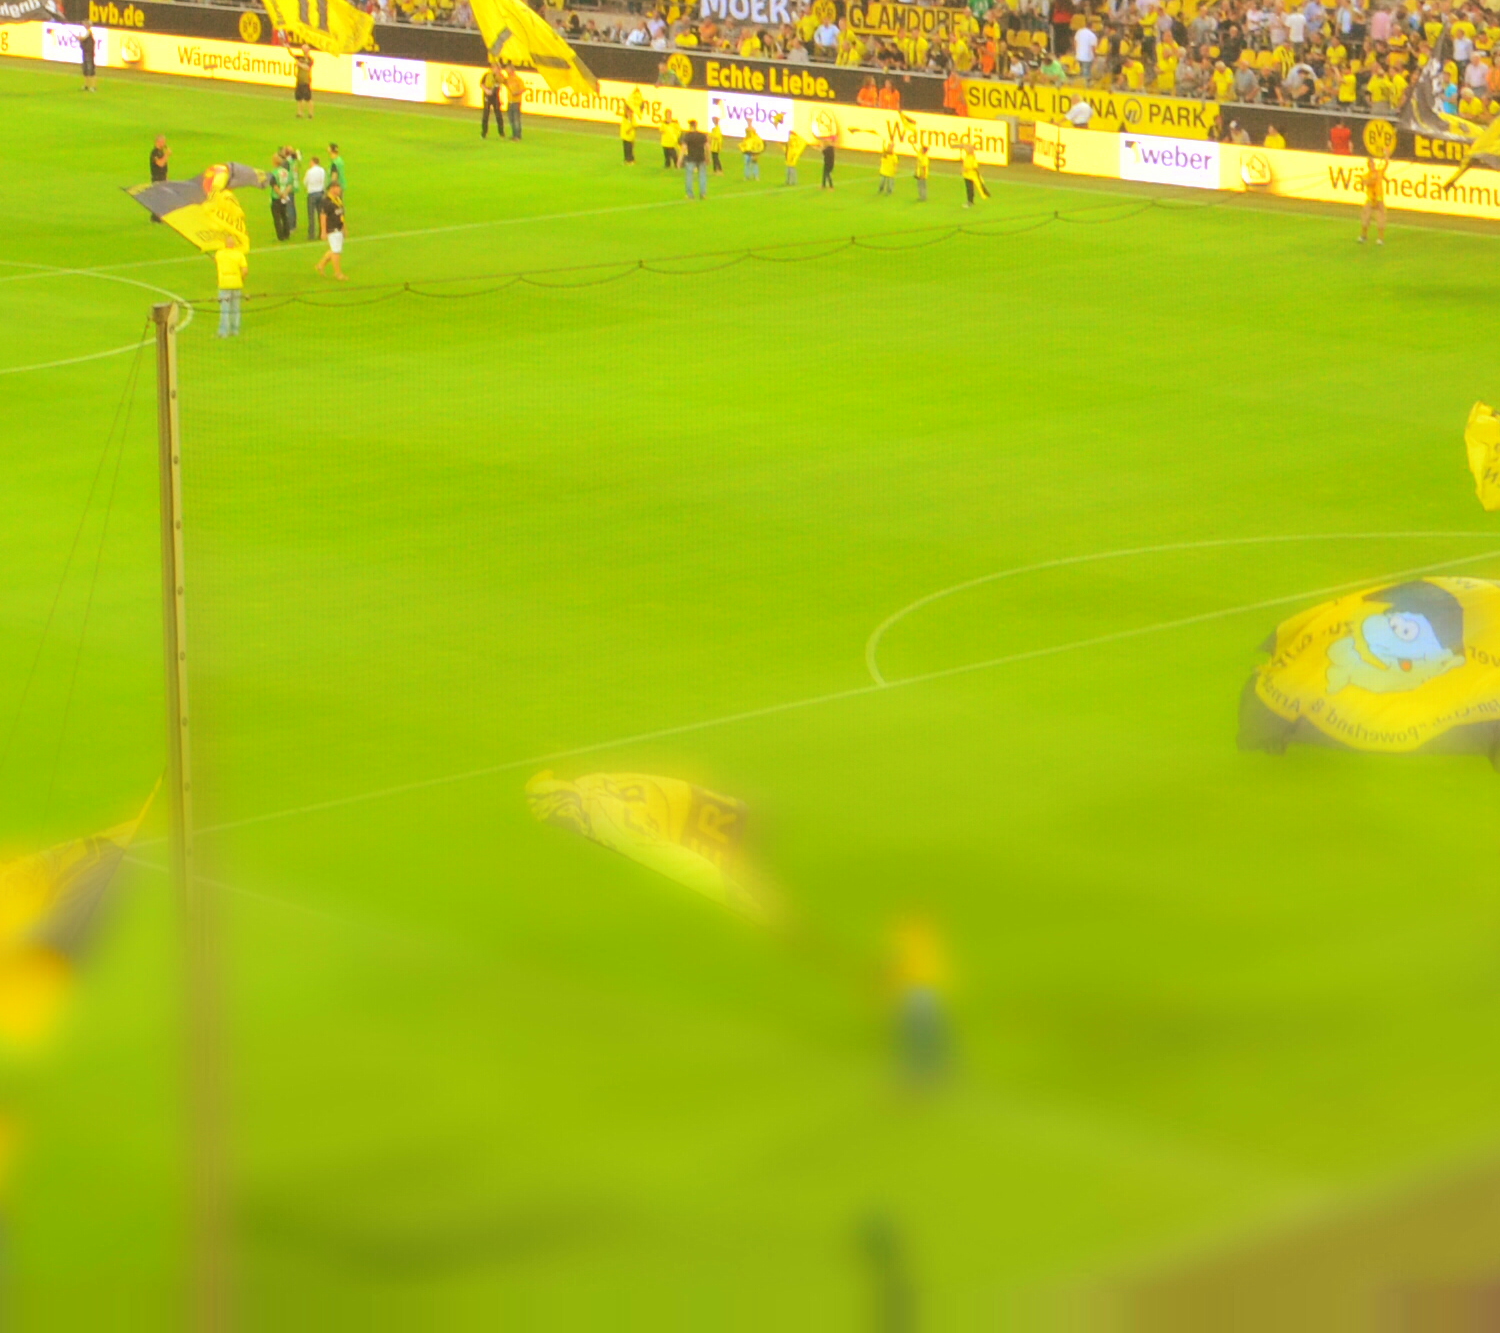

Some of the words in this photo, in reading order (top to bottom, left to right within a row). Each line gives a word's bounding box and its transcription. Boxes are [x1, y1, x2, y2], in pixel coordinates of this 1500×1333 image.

[367, 58, 422, 87] weber
[706, 60, 766, 93] Echte
[768, 66, 836, 100] Liebe.
[968, 86, 1045, 114] SIGNAL
[1051, 94, 1118, 120] IDNA
[1148, 103, 1207, 129] PARK
[1141, 141, 1214, 171] weber
